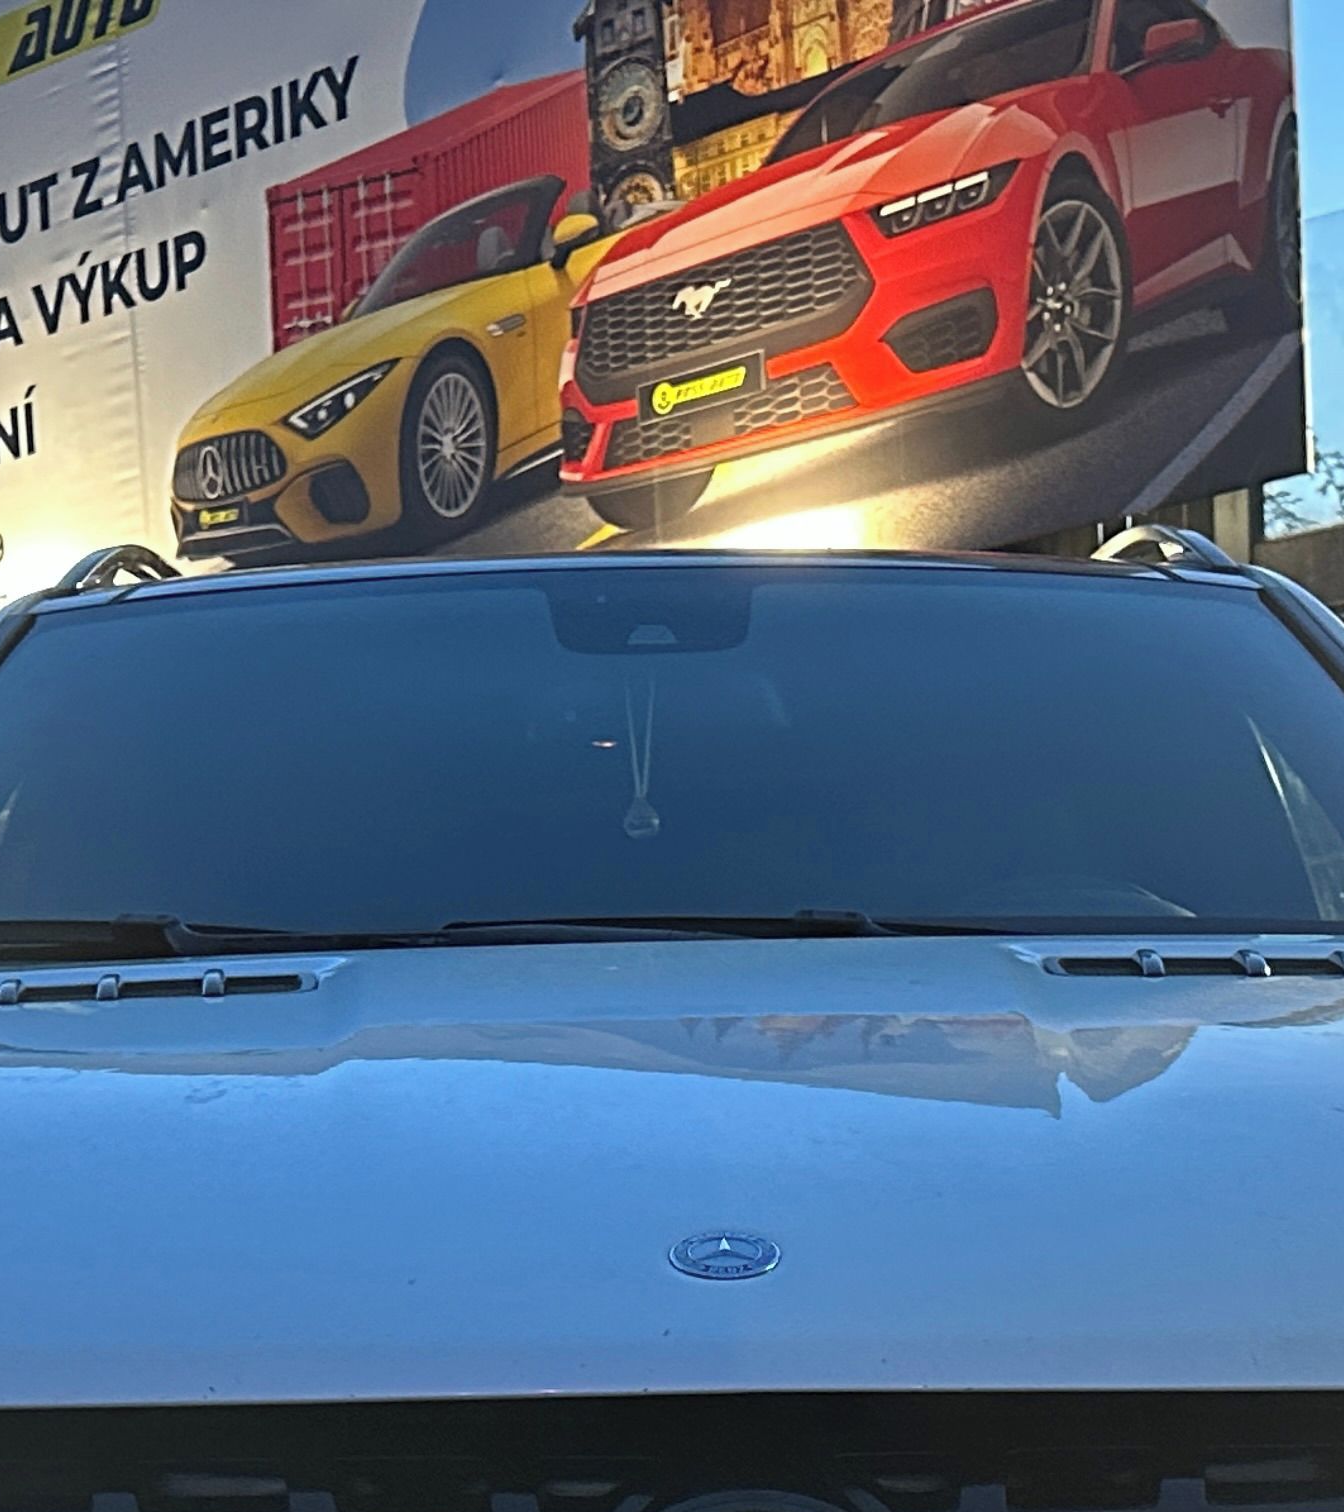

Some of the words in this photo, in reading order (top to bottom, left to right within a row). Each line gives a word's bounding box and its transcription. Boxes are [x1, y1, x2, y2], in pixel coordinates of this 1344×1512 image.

[72, 157, 104, 219] Z
[116, 55, 360, 203] AMERIKY
[33, 230, 206, 335] VÝKUP
